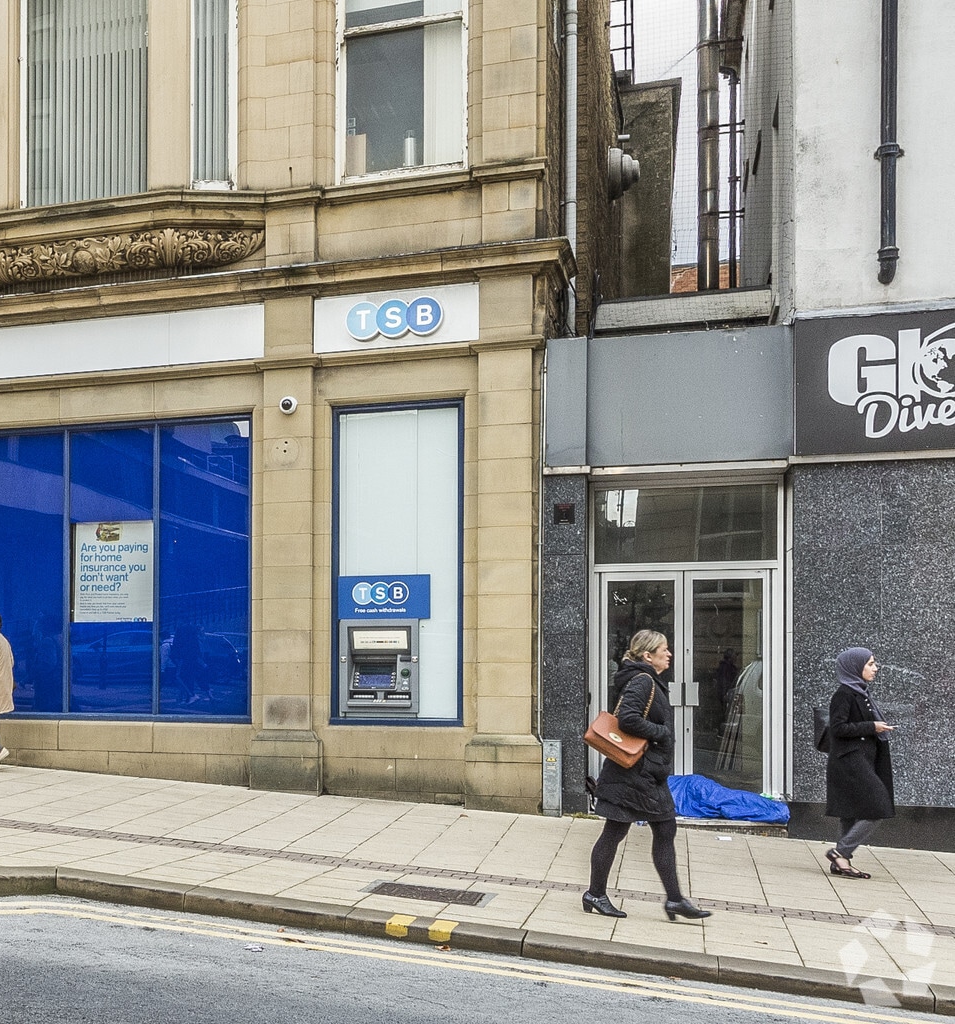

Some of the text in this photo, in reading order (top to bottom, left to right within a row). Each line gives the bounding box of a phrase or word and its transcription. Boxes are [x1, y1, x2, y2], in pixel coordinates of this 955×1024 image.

[355, 303, 434, 331] TSB
[80, 542, 148, 553] Are you paying
[80, 553, 122, 561] for home
[80, 563, 146, 573] insurance you
[80, 572, 129, 582] don't want
[80, 582, 121, 592] or need?
[358, 586, 404, 600] TSB
